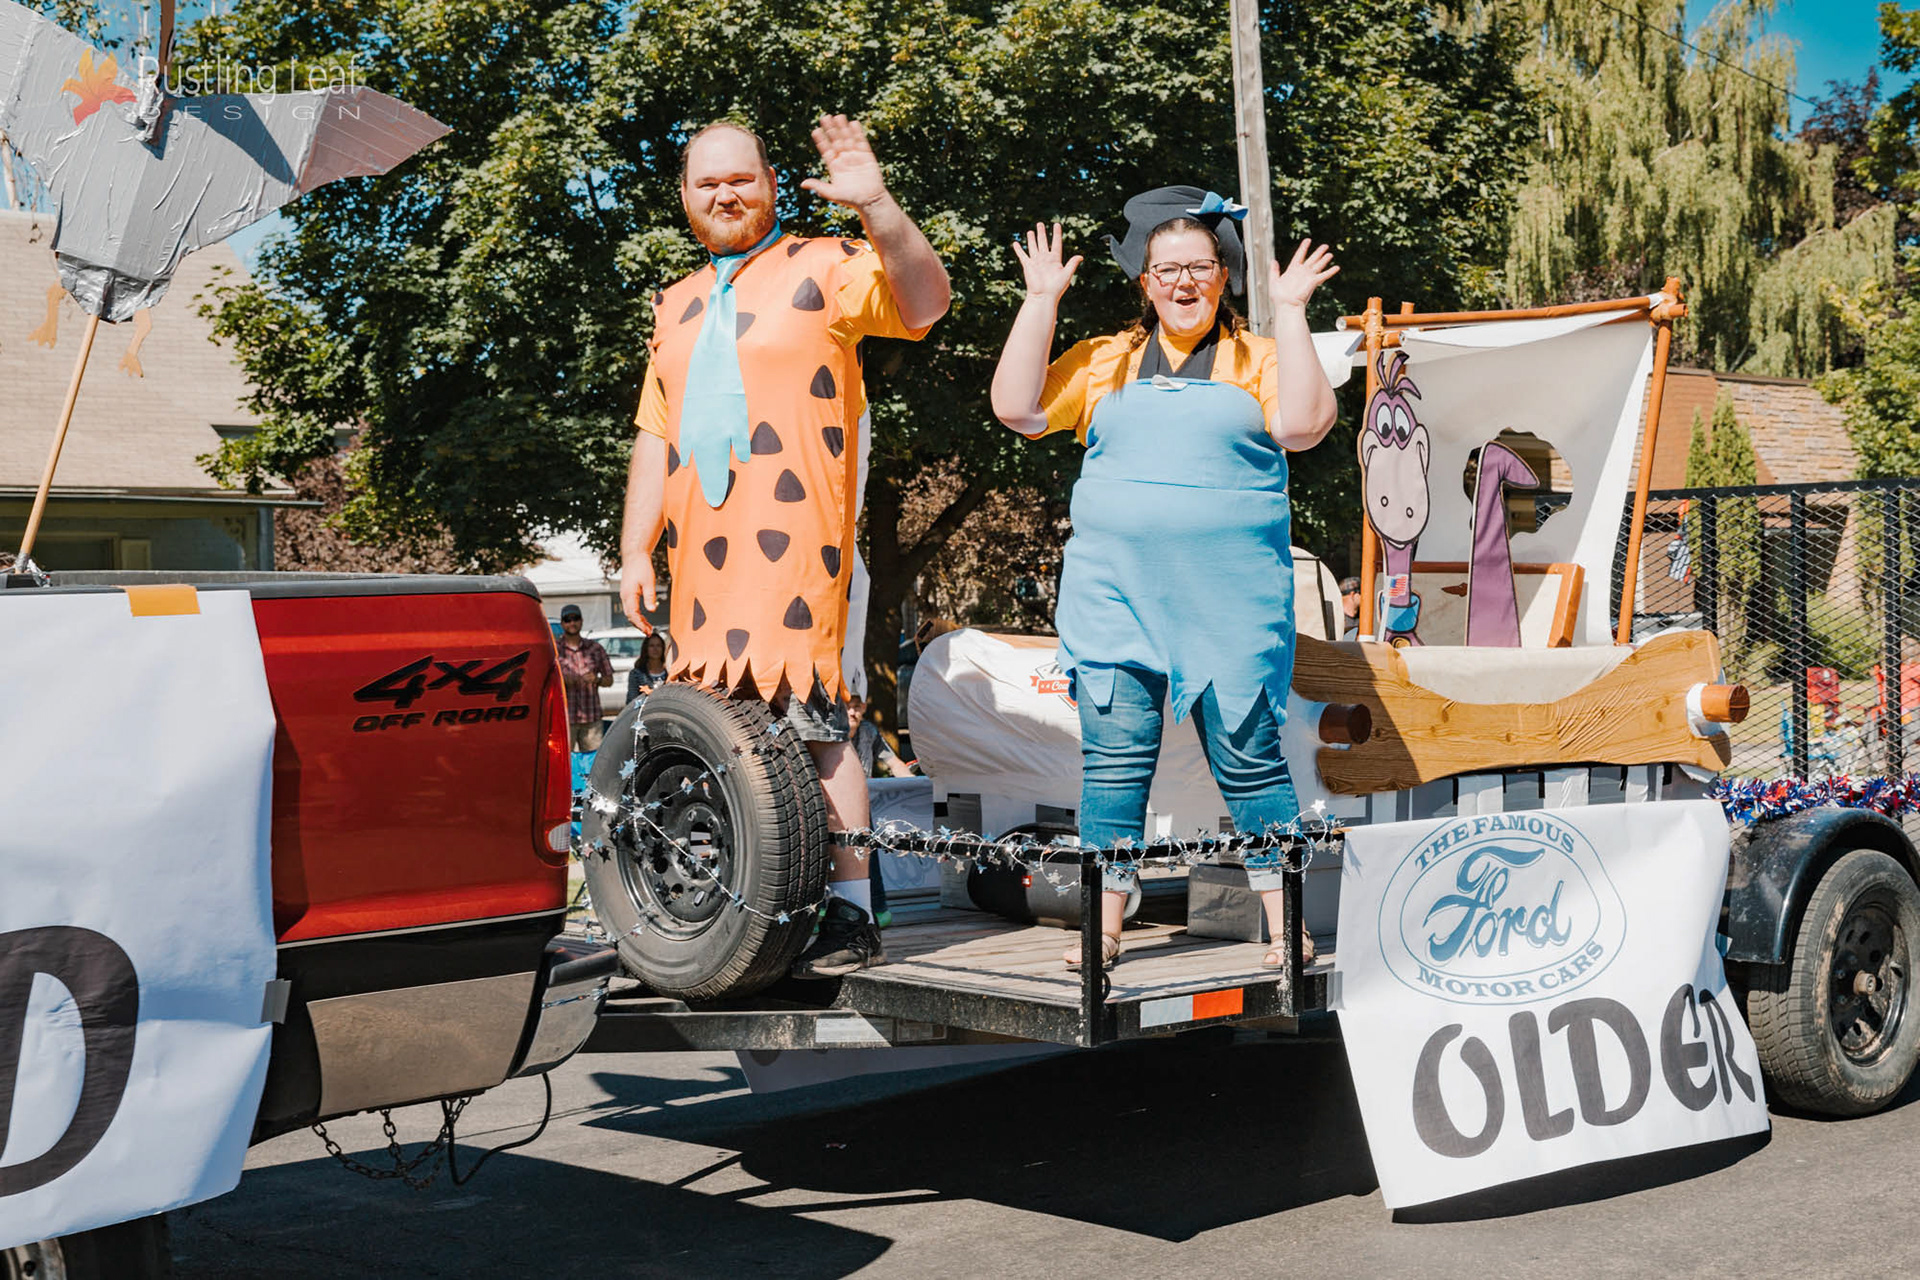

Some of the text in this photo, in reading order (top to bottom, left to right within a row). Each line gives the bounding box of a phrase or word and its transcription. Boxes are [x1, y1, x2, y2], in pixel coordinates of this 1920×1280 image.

[353, 704, 531, 732] OFF ROAD
[1415, 814, 1575, 872] THE FAMOUS
[1422, 845, 1572, 967] Ford
[1416, 940, 1604, 998] MOTOR CARS
[1412, 983, 1756, 1159] OLDER
